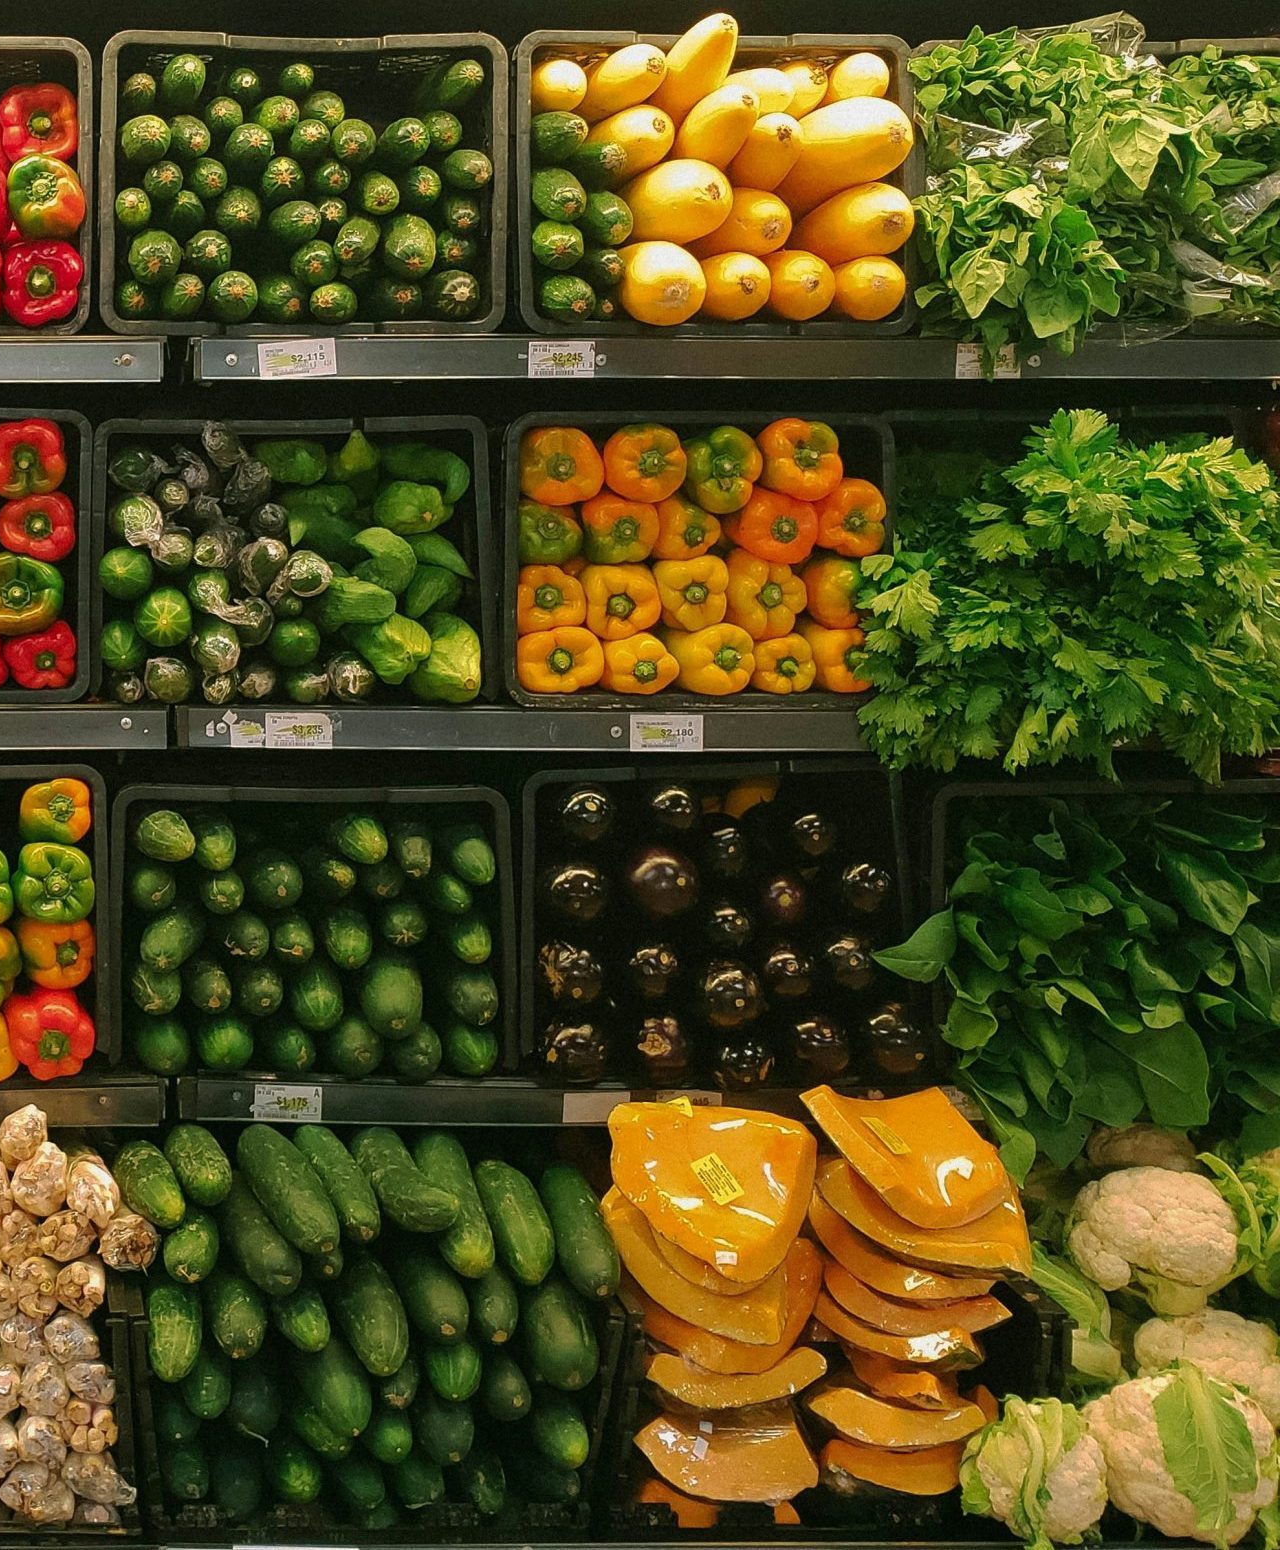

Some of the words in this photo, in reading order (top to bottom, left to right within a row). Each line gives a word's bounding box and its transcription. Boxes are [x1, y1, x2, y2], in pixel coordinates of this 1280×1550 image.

[588, 343, 596, 352] A
[290, 352, 325, 363] $2,115
[552, 352, 584, 363] $2,245
[292, 724, 324, 735] $3,235
[660, 728, 694, 738] $2,180
[314, 1088, 320, 1098] A
